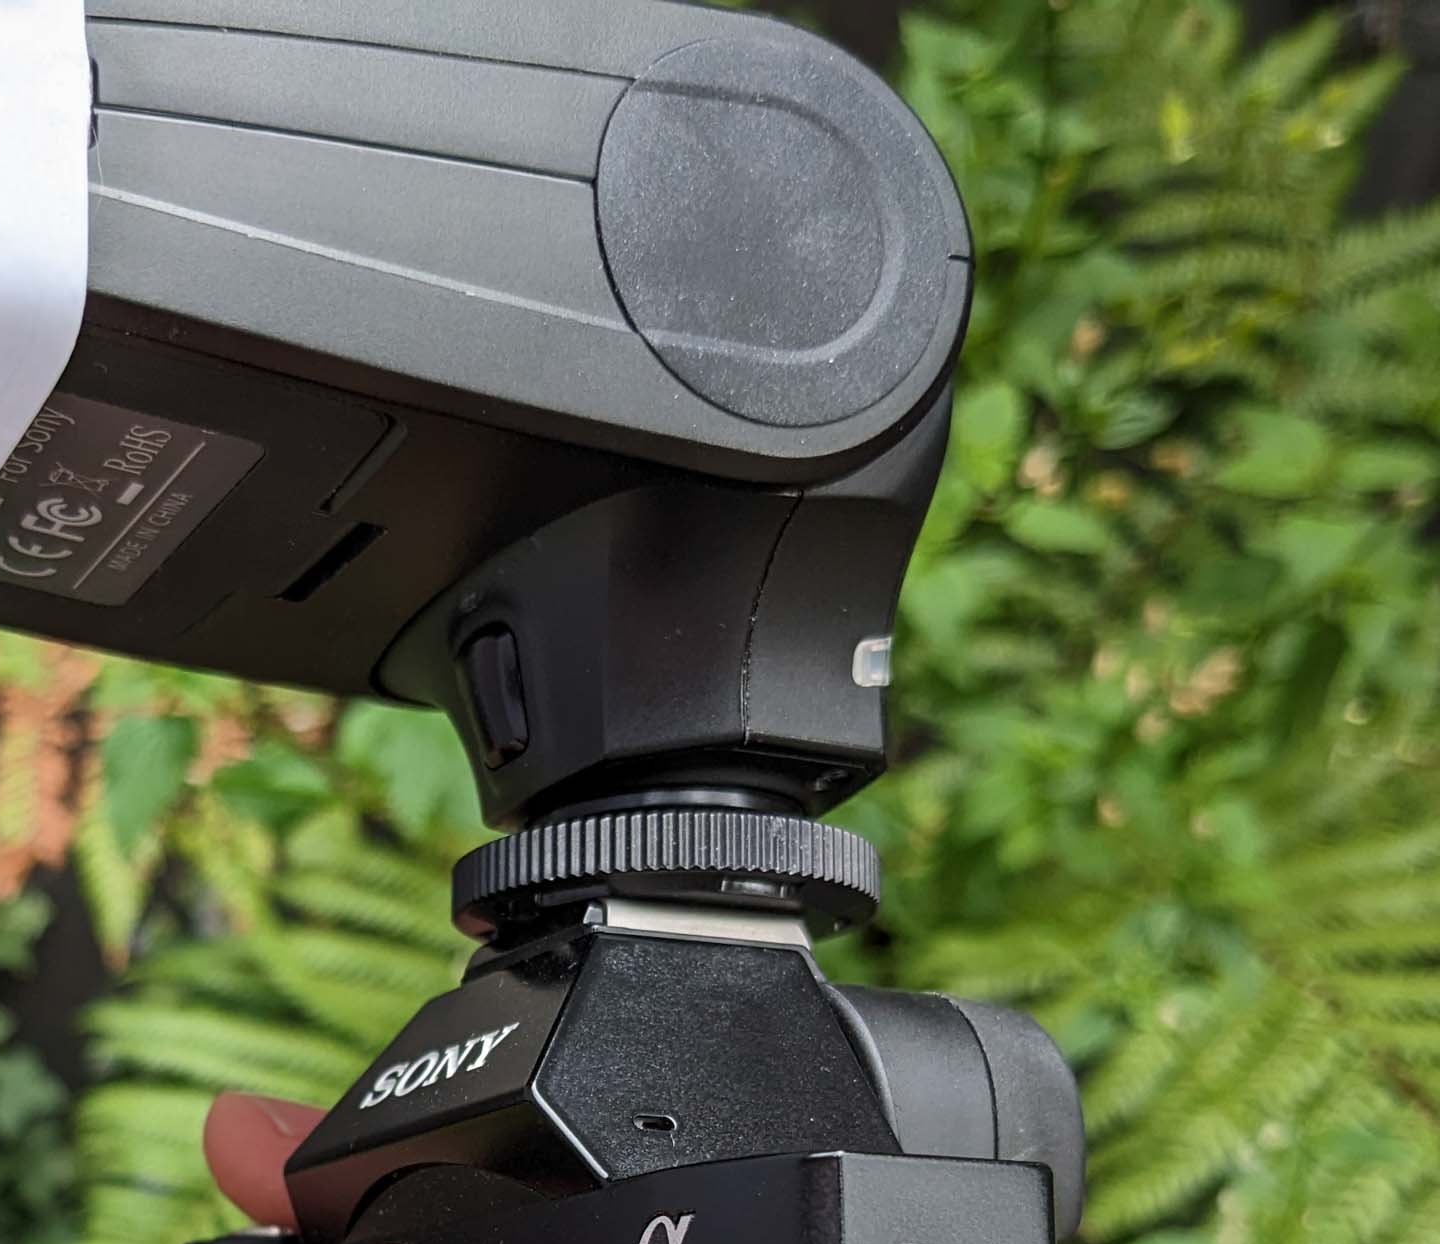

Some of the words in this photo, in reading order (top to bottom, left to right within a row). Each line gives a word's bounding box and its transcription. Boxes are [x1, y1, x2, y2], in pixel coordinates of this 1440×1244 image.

[103, 425, 173, 475] RoHS
[108, 540, 148, 571] MADE
[136, 526, 160, 541] IN
[149, 492, 194, 527] CHINA
[360, 1021, 521, 1110] SONY
